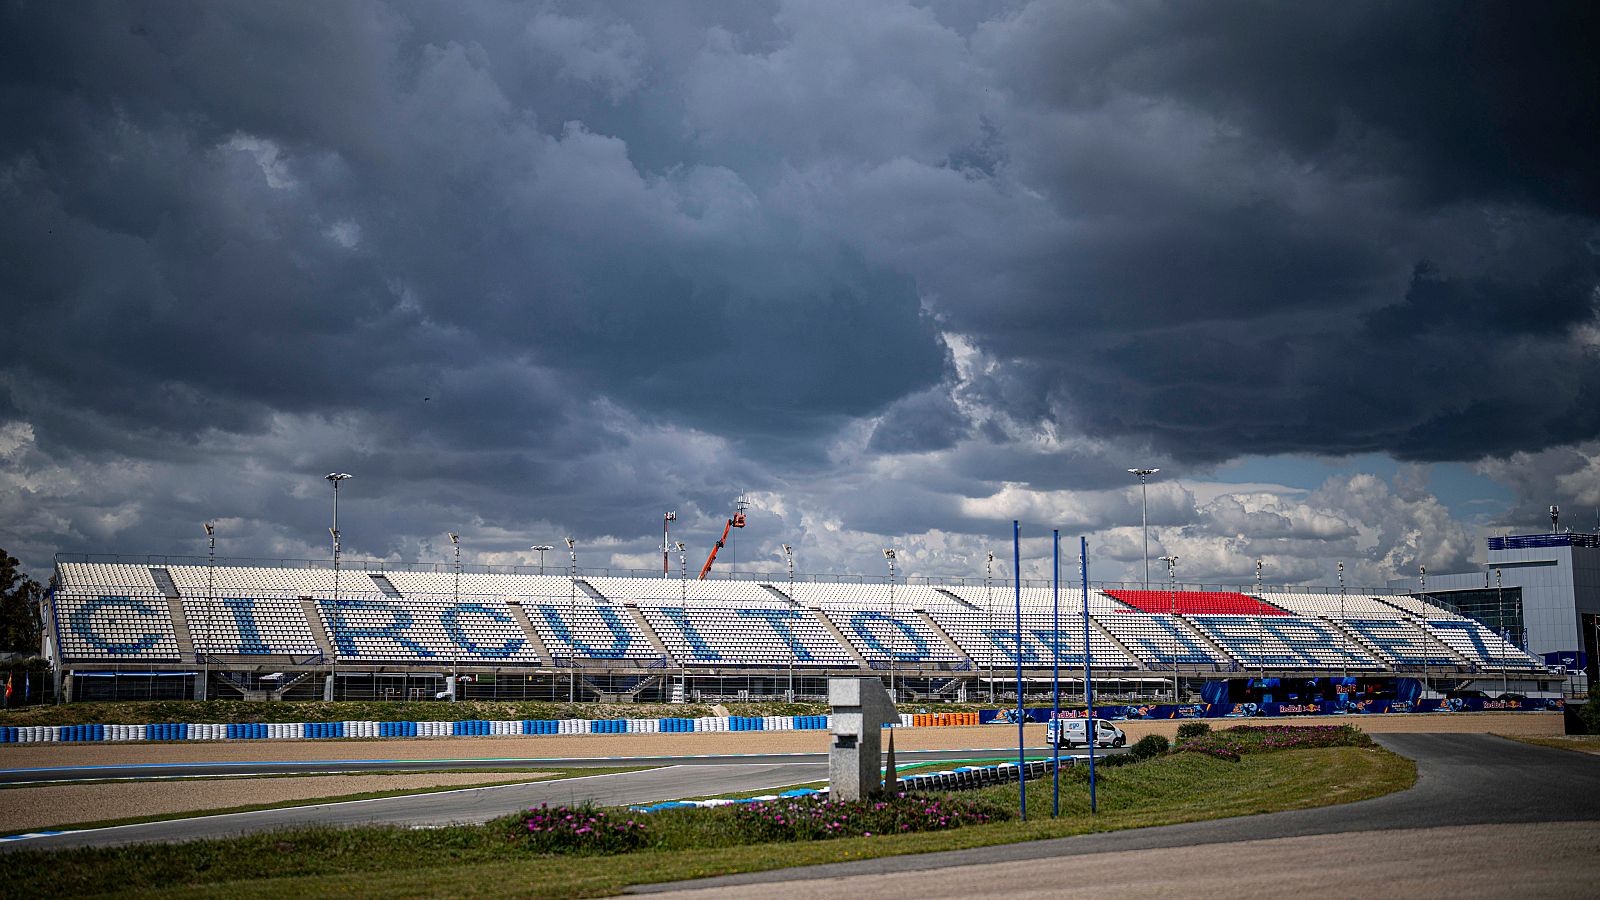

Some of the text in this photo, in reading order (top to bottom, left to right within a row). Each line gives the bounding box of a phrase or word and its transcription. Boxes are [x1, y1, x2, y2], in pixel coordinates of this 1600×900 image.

[69, 596, 931, 662] CIRCUITO
[979, 629, 1098, 662] DE
[1136, 615, 1543, 667] JEREZ
